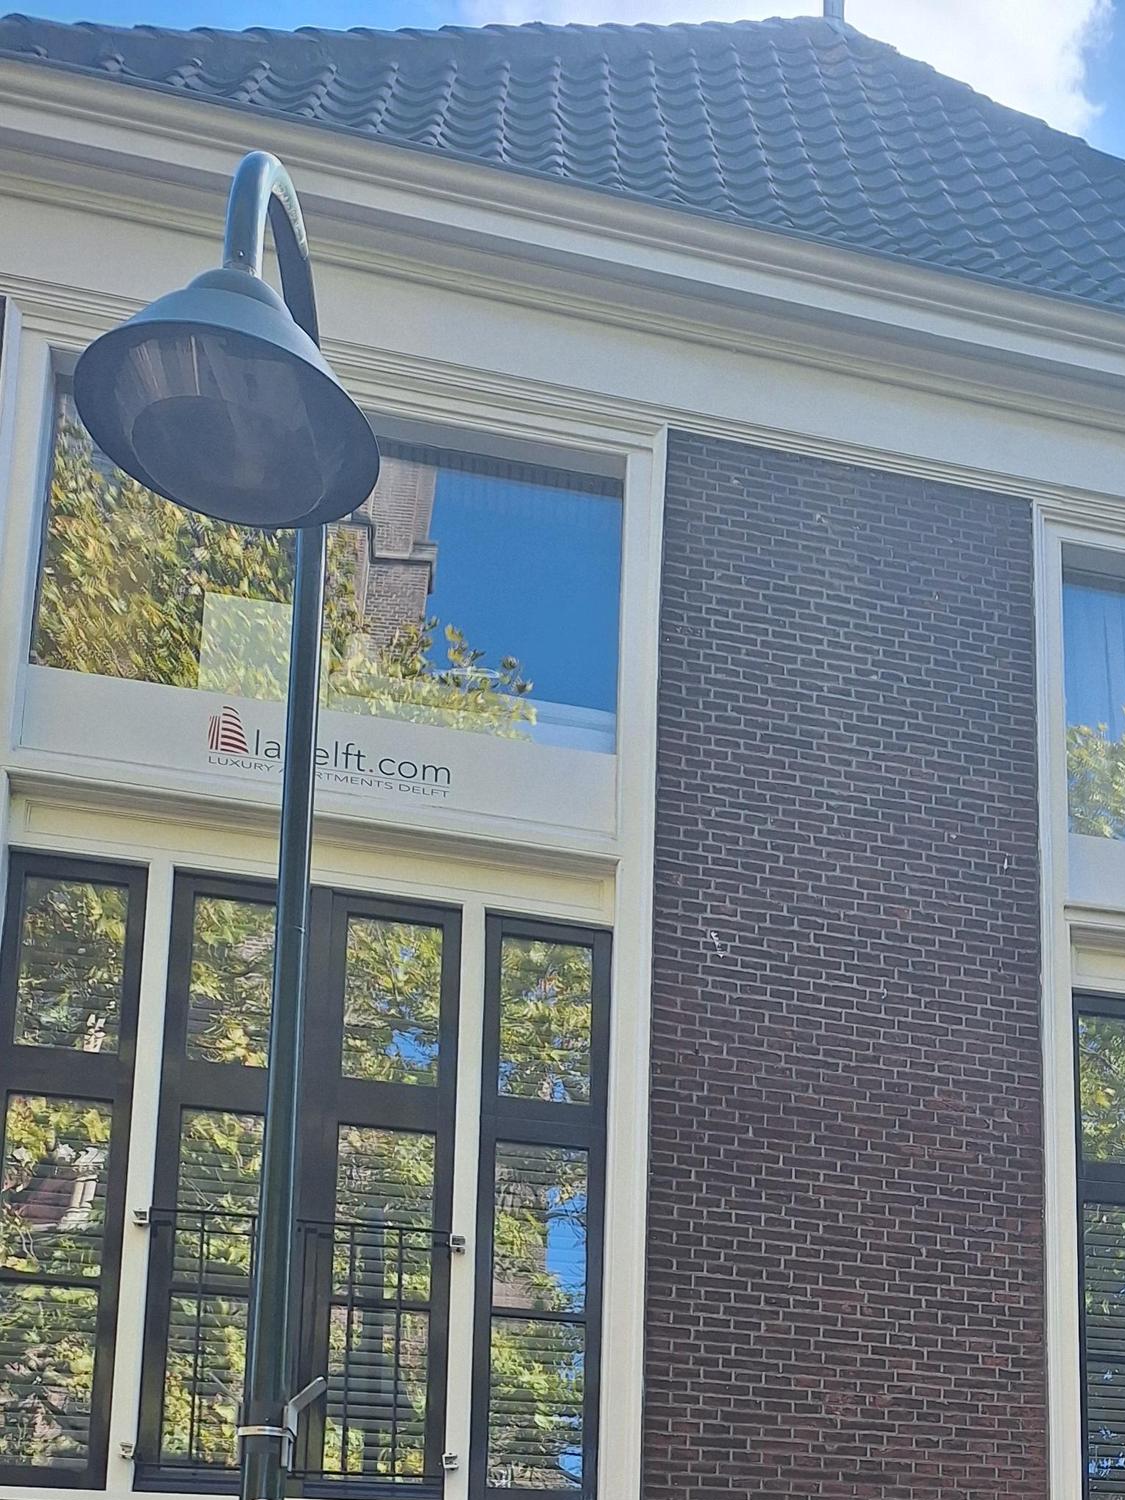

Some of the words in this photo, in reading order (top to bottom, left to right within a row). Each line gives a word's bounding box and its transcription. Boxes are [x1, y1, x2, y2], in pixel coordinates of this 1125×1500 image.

[208, 755, 274, 772] LUXURY
[398, 783, 450, 798] DELFT
[254, 728, 451, 785] laelft.com
